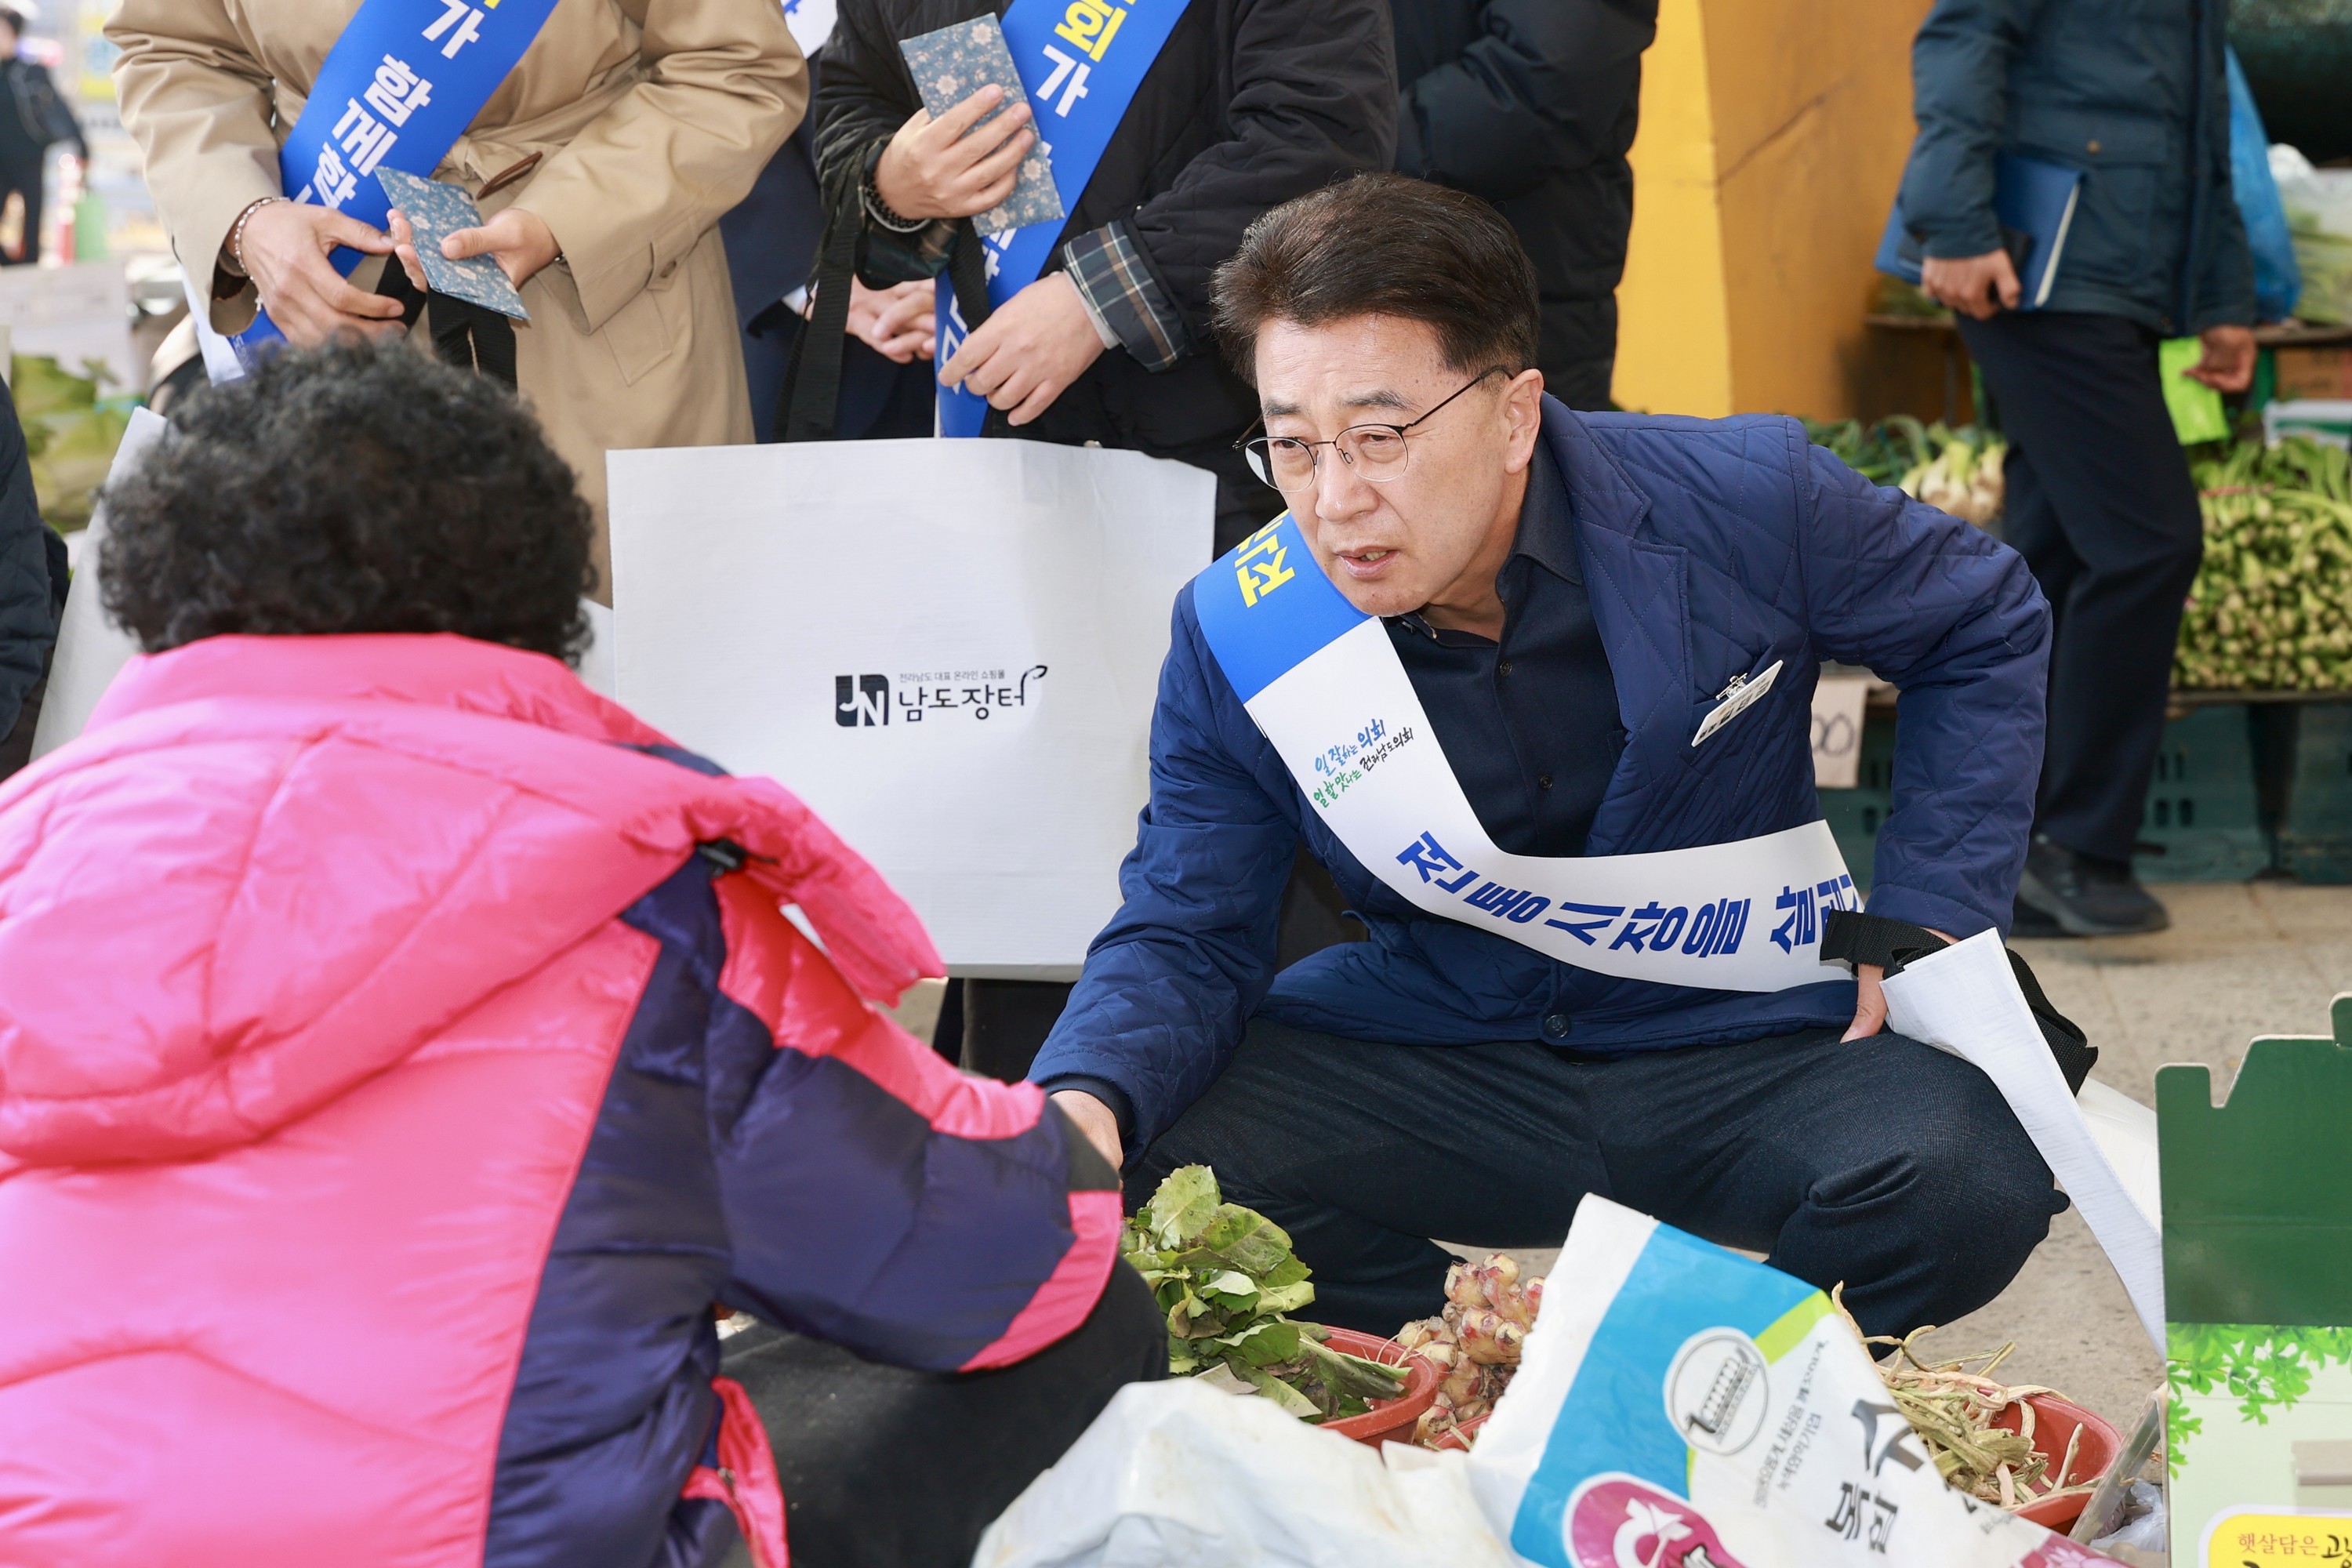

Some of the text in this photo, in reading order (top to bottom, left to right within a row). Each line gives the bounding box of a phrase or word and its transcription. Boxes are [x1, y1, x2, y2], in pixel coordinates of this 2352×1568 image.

[331, 53, 433, 177] 함께
[898, 665, 1048, 722] 남도장터
[899, 669, 1006, 683] 전라남도 대표 온라인 쇼핑몰
[1357, 718, 1387, 749] 의회
[1359, 727, 1414, 772] 전라남도의회
[1396, 830, 1751, 958] 전통시장을
[2237, 1533, 2319, 1556] 햇살담은
